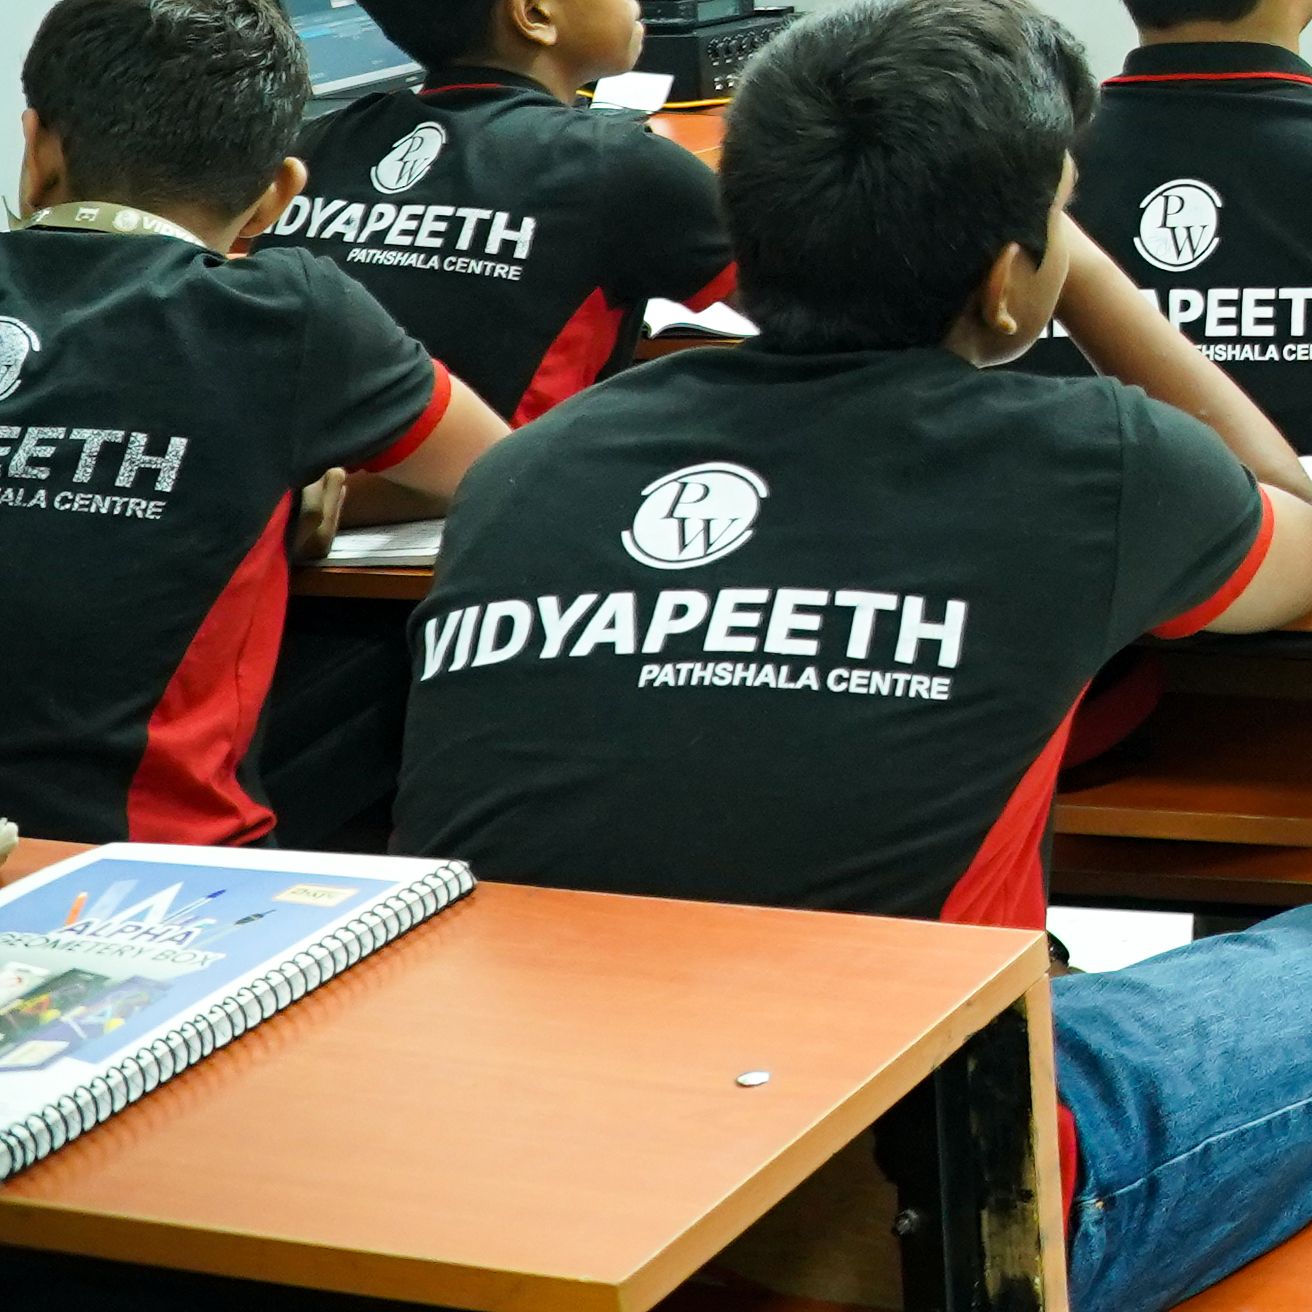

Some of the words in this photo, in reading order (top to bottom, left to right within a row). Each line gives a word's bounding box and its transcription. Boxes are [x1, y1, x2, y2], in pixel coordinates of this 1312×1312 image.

[262, 195, 537, 260] DYAPEETH
[346, 248, 439, 272] PATHSHALA
[443, 255, 524, 281] CENTRE
[1196, 344, 1280, 362] HSHALA
[0, 487, 47, 509] ALA
[53, 491, 167, 520] CENTRE
[420, 587, 969, 682] VIDYAPEETH
[636, 662, 820, 692] PATHSHALA
[827, 668, 953, 701] CENTRE
[151, 948, 216, 967] BOX
